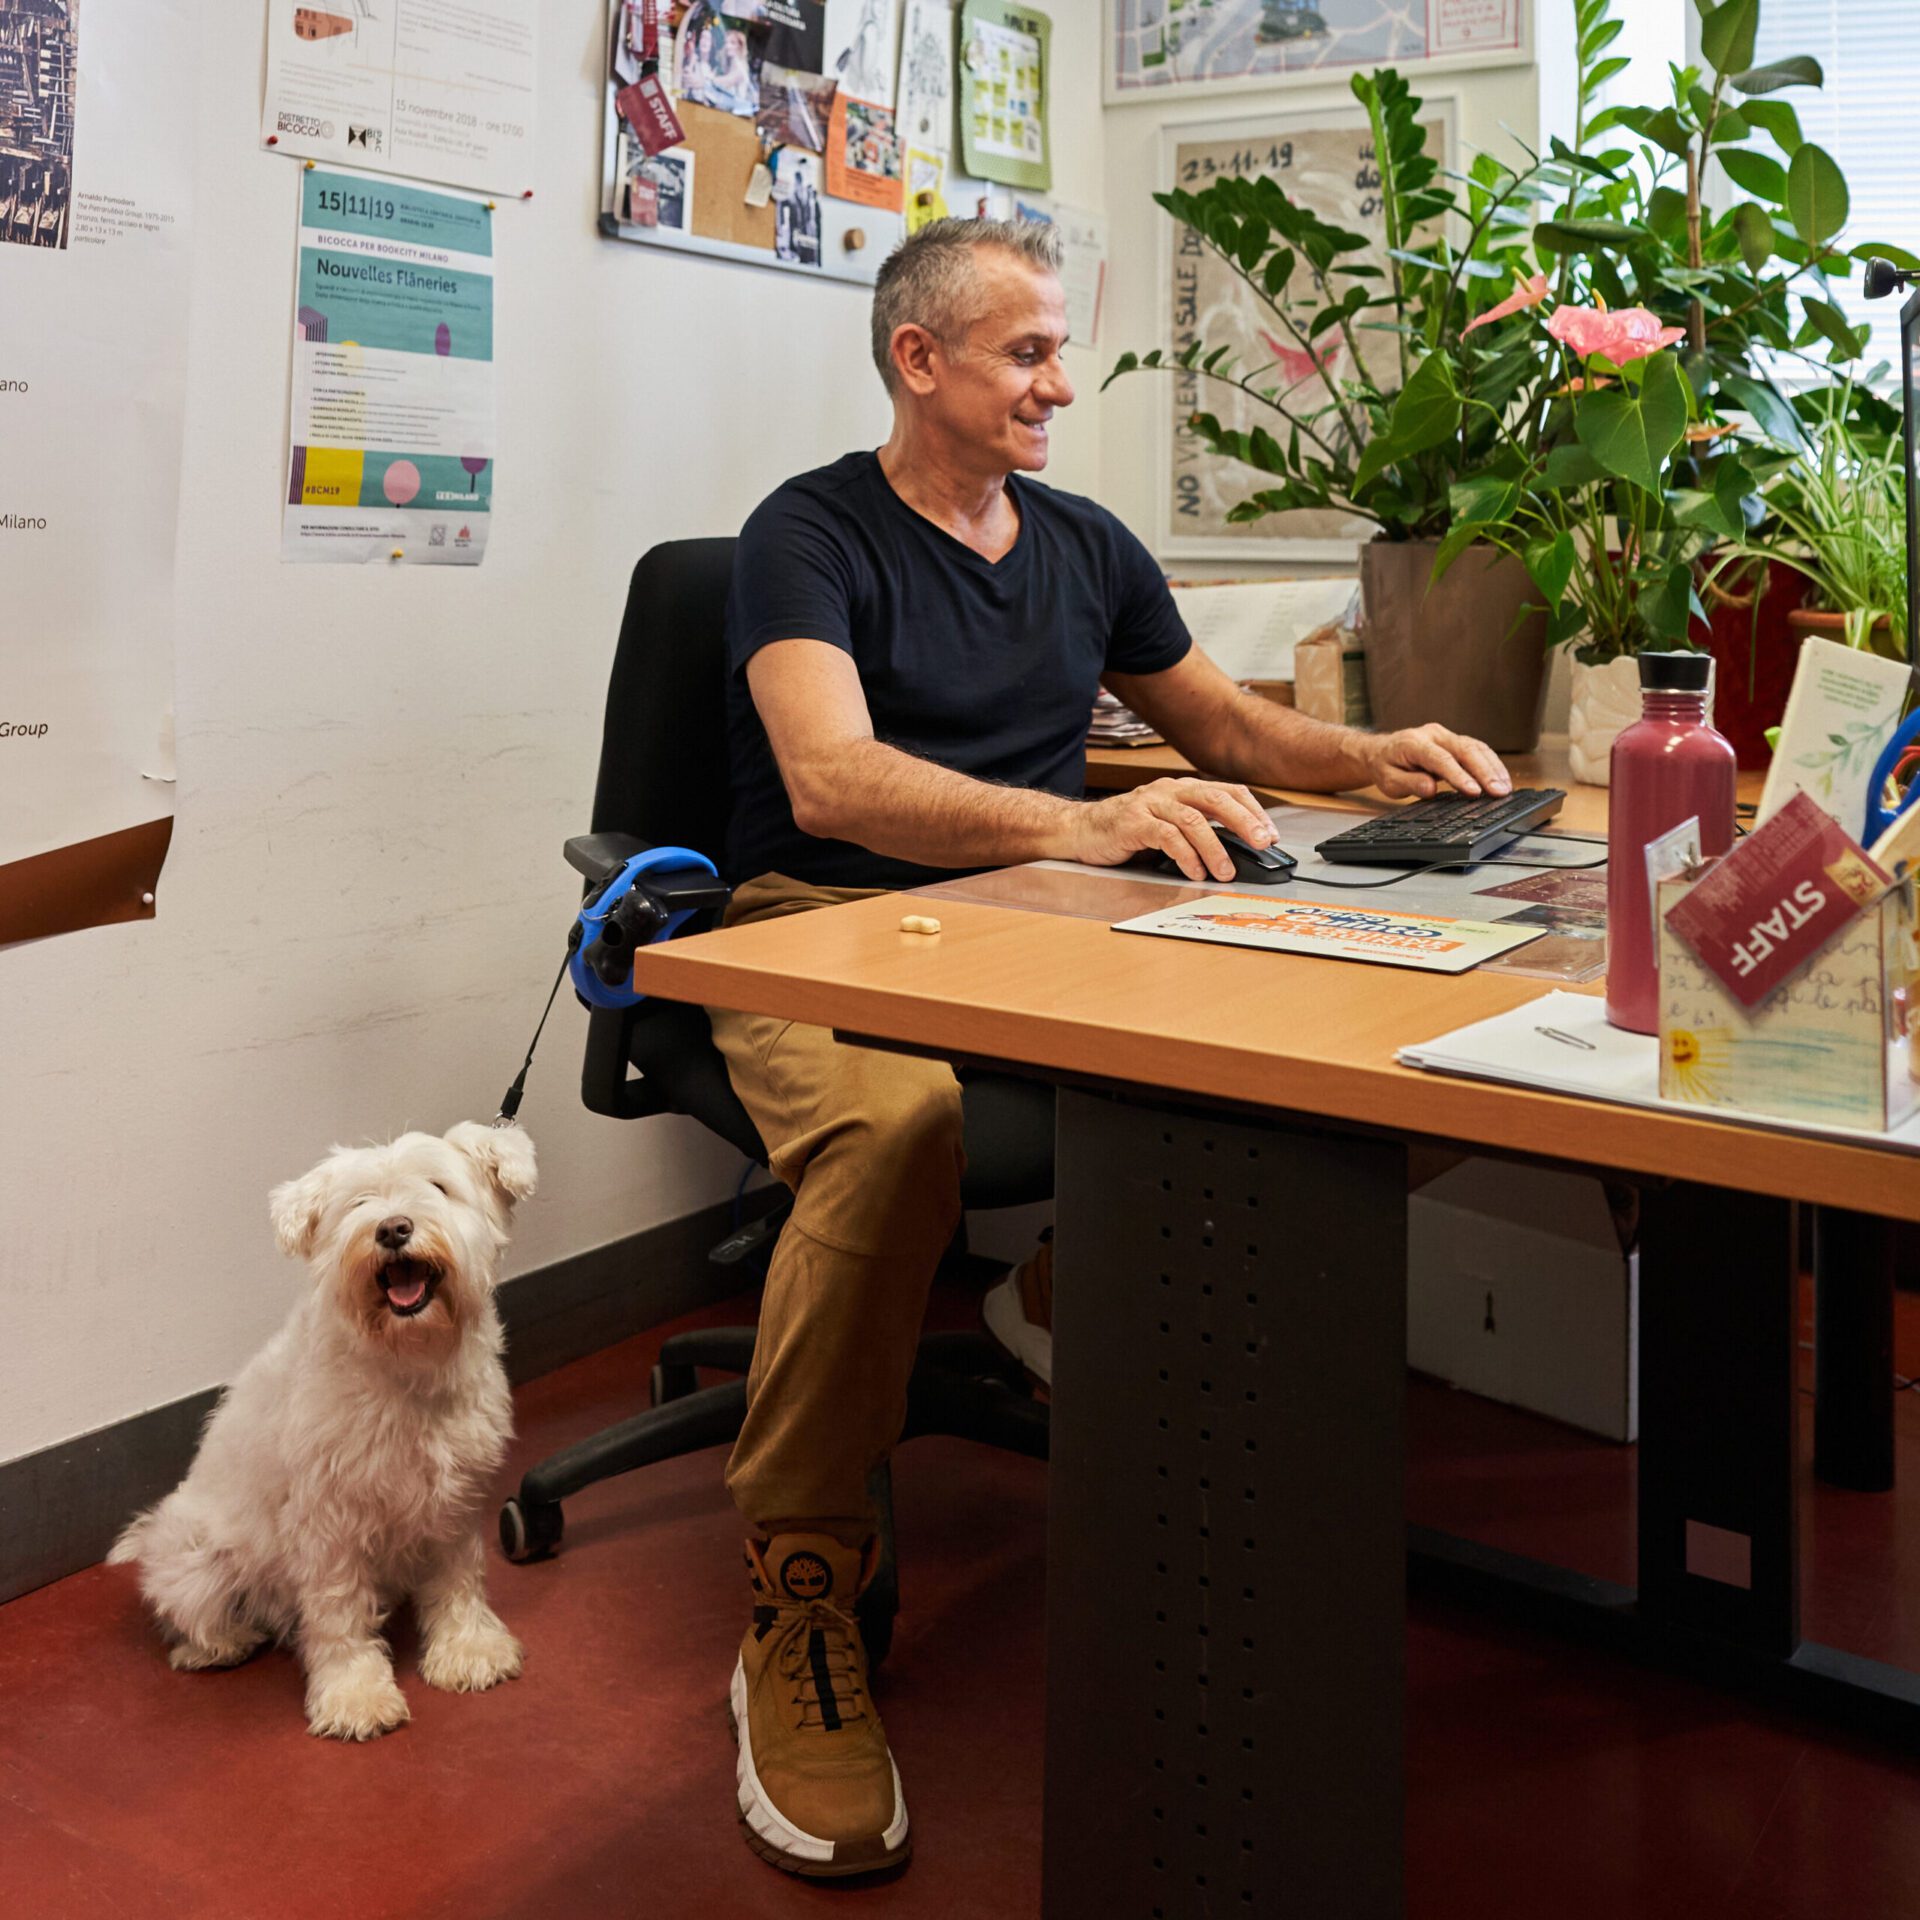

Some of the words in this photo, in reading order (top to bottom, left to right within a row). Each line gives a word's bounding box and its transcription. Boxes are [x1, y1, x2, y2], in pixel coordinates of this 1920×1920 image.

[278, 111, 321, 127] DISTRETTO
[649, 97, 679, 140] STAFF
[277, 121, 321, 138] BICOCCA
[77, 191, 102, 202] Arnaldo
[317, 234, 358, 249] BICOCCA
[360, 240, 375, 251] PER
[377, 243, 418, 258] BOOKCITY
[419, 251, 449, 264] MILANO
[316, 256, 393, 285] Nouvelles
[396, 269, 459, 295] Flâneries
[1175, 265, 1198, 329] SULLE
[305, 485, 341, 496] #BCM19
[1175, 474, 1201, 518] NO
[0, 514, 47, 530] Milano
[0, 722, 49, 739] Group
[1284, 914, 1434, 937] Quinto
[1291, 908, 1385, 923] Amico
[1731, 880, 1827, 977] STAFF
